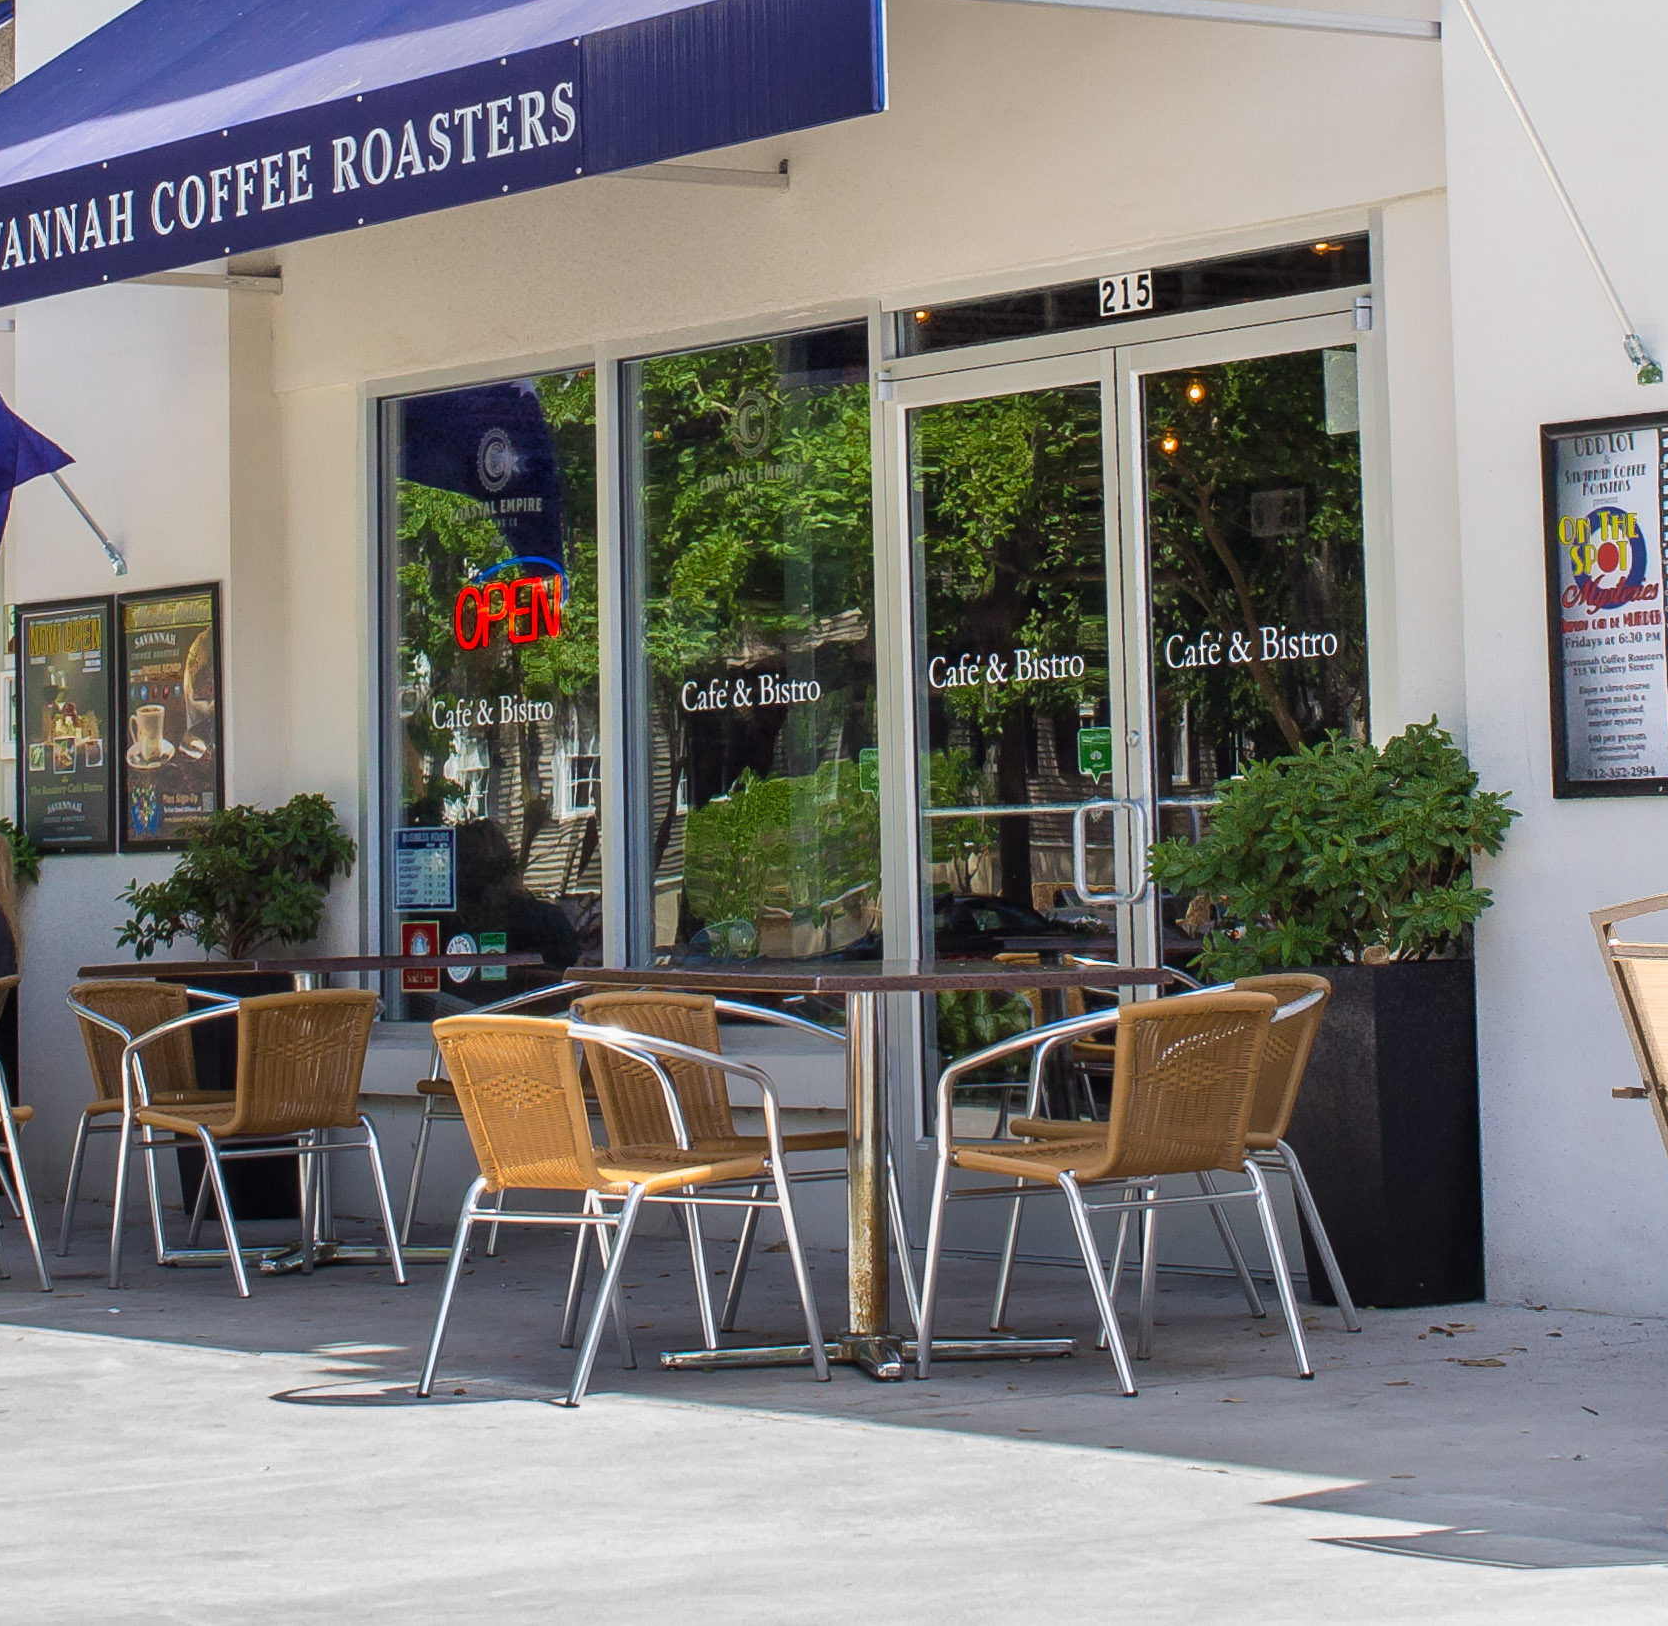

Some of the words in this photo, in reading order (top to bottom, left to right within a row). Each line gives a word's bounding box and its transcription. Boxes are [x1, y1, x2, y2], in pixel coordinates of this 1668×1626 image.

[150, 144, 314, 237] COFFEE
[331, 81, 577, 195] ROASTERS
[1101, 272, 1151, 314] 215
[500, 497, 542, 513] EMPIRE
[1558, 514, 1592, 546] ON
[1598, 510, 1640, 542] THE
[1561, 573, 1660, 614] Mysteries
[454, 574, 562, 651] OPEN
[29, 623, 61, 657] NOW
[63, 618, 101, 654] OPEN
[134, 631, 177, 650] SAVANNAH
[1228, 631, 1253, 663] &
[1258, 626, 1338, 662] Bistro
[1564, 635, 1602, 650] Fridays
[1605, 636, 1615, 645] at
[1618, 631, 1642, 644] 6:30
[1645, 631, 1661, 642] PM
[986, 653, 1008, 684] &
[1014, 648, 1085, 682] Bistro
[1589, 664, 1598, 674] W
[1600, 662, 1626, 675] Liberty
[1628, 662, 1654, 672] Street
[1601, 654, 1626, 665] Coffee
[732, 678, 753, 708] &
[757, 674, 821, 707] Bistro
[477, 698, 494, 725] &
[499, 694, 554, 725] Bistro
